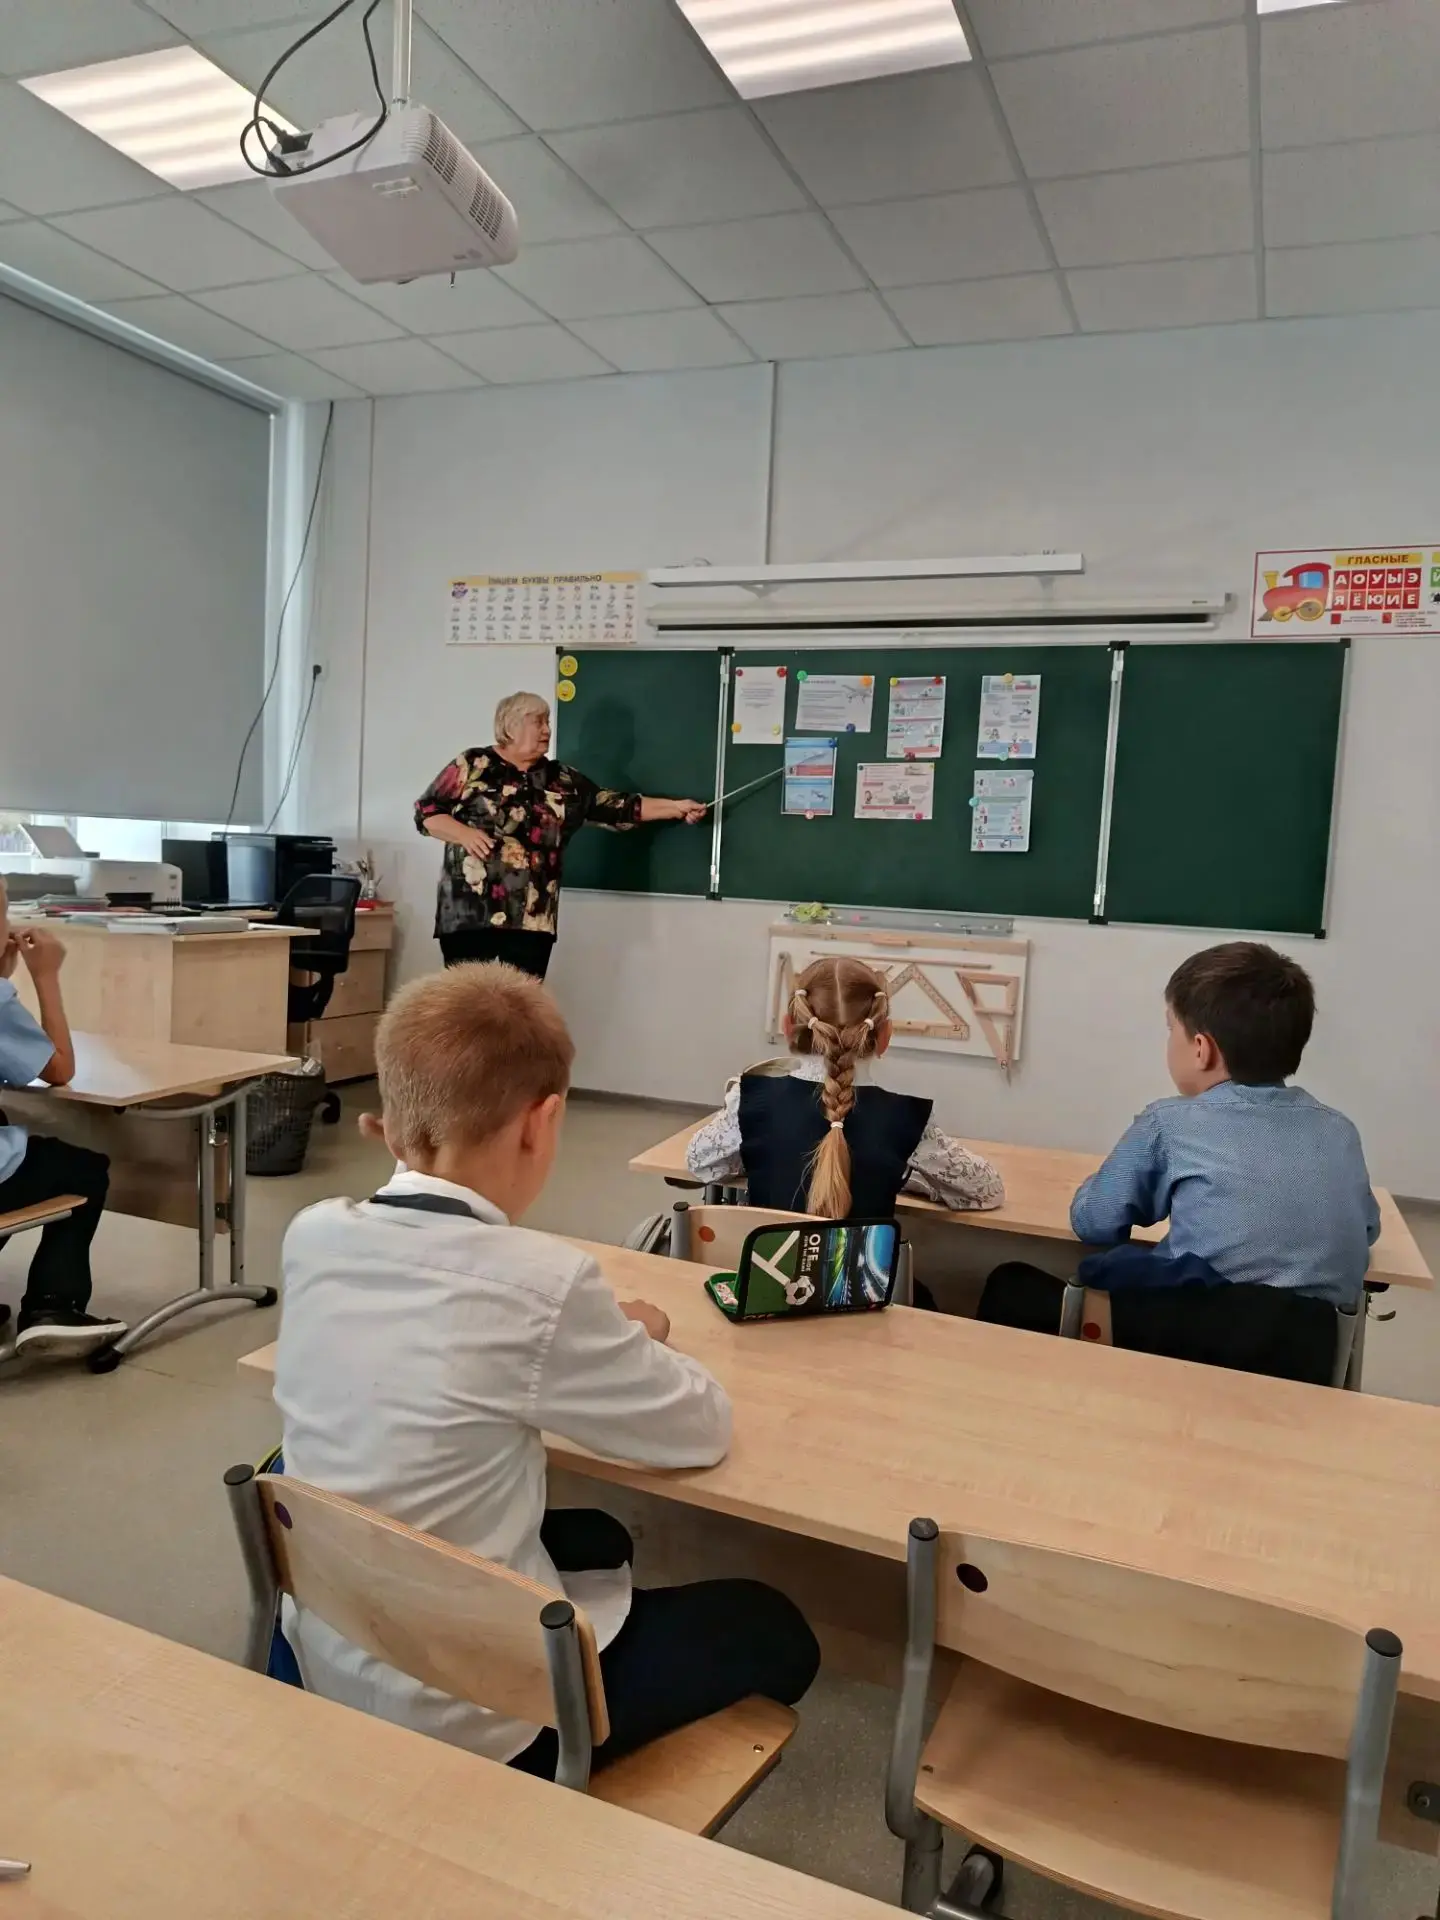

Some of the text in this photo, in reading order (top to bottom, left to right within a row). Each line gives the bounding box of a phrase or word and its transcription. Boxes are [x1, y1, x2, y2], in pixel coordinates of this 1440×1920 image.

[1347, 554, 1409, 565] ГЛАСНЫЕ
[522, 576, 549, 584] БУКВЫ
[554, 574, 602, 584] ПРАВИЛЬНО
[1336, 572, 1418, 585] А О У Ы Э
[1334, 595, 1344, 605] Я
[1353, 593, 1361, 606] Ё
[1367, 594, 1383, 605] Ю
[1387, 595, 1400, 605] И
